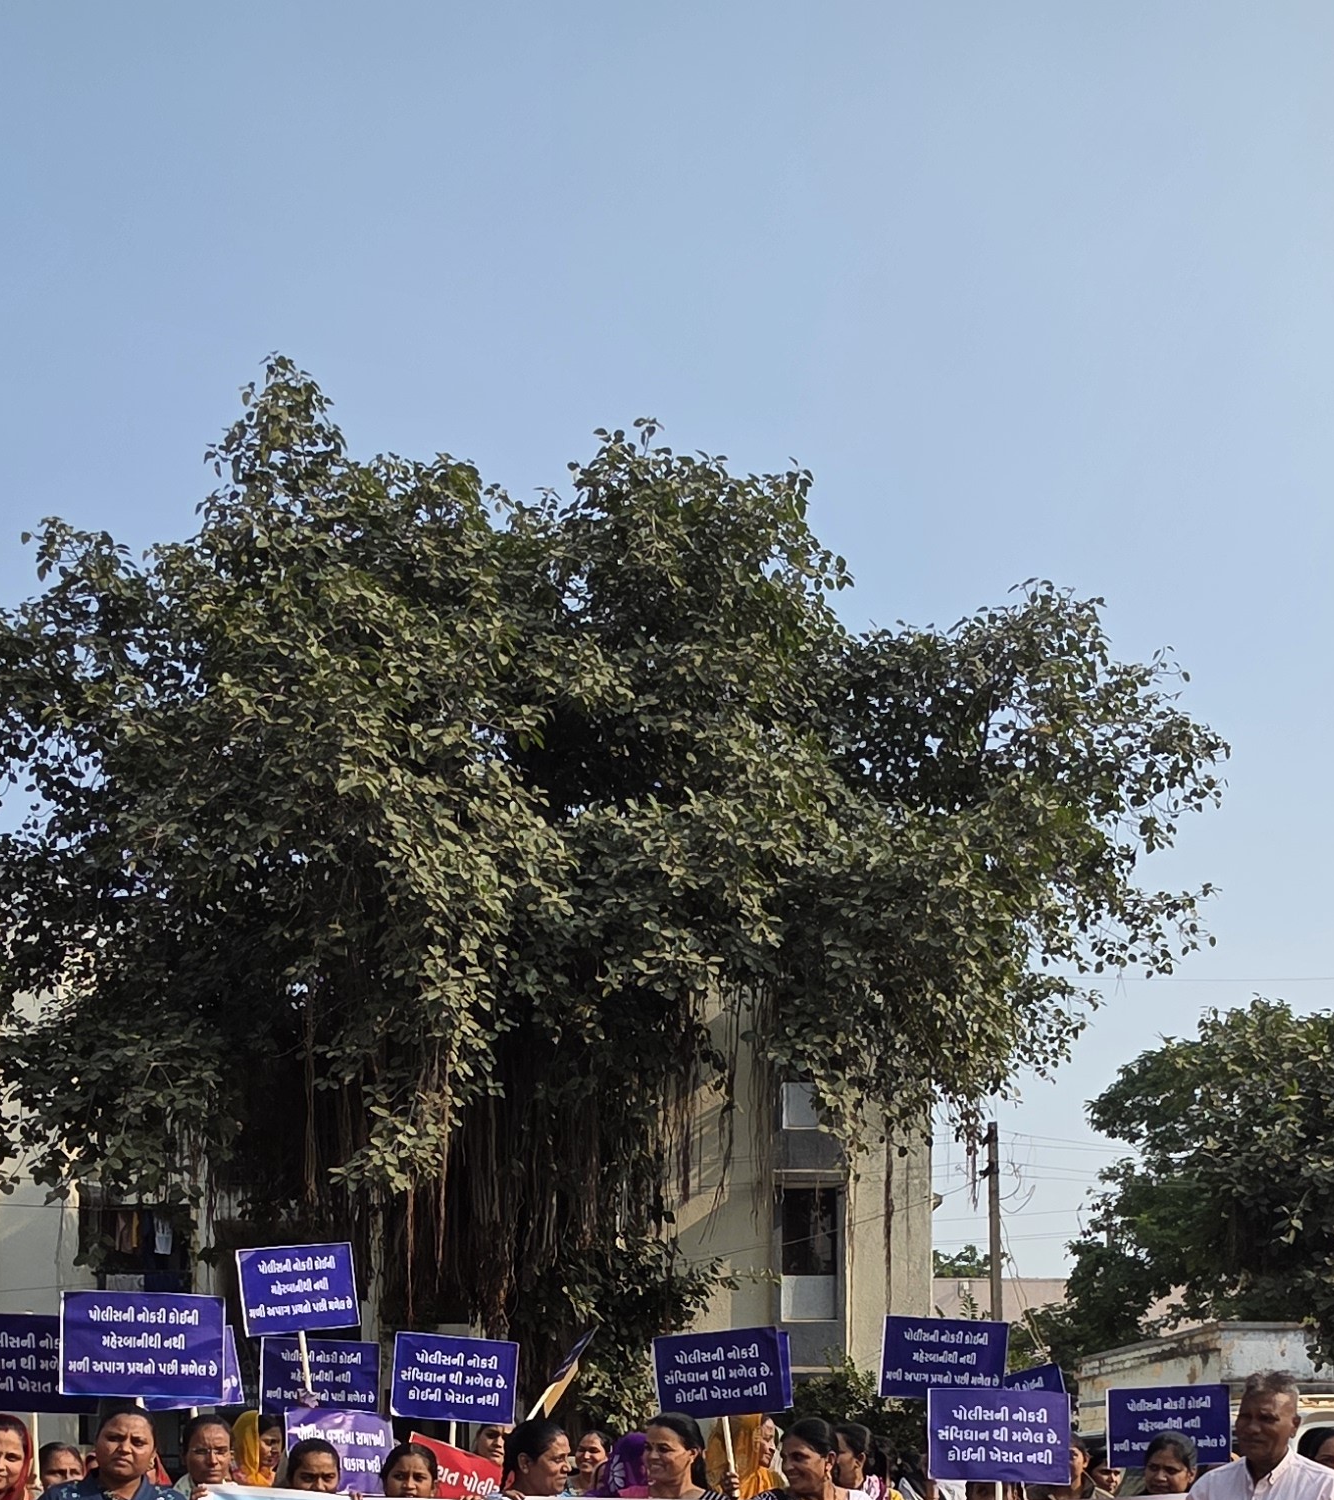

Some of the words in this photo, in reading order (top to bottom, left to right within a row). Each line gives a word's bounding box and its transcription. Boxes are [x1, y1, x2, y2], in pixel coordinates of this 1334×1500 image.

[88, 1305, 135, 1322] પોલીસની
[137, 1306, 166, 1323] નોકરી
[168, 1308, 199, 1325] કોઈની
[163, 1333, 185, 1350] નથી
[20, 1354, 36, 1370] થી
[415, 1349, 465, 1367] પોલીસની
[467, 1354, 498, 1370] નોકરી
[674, 1347, 724, 1364] પોલીસની
[727, 1343, 759, 1359] નોકરી
[68, 1356, 90, 1373] મળી
[158, 1359, 178, 1375] પછી
[181, 1359, 206, 1376] મળેલ
[208, 1360, 218, 1376] છે
[664, 1370, 709, 1385] સંવિધાન
[712, 1366, 726, 1380] થી
[729, 1364, 757, 1379] મળેલ
[17, 1376, 51, 1393] ખેરાત
[401, 1366, 446, 1384] સંવિધાન
[449, 1371, 463, 1385] થી
[465, 1373, 493, 1388] મળેલ
[444, 1389, 474, 1404] ખેરાત
[477, 1393, 499, 1406] નથી
[675, 1387, 708, 1403] કોઈની
[710, 1385, 741, 1399] ખેરાત
[743, 1382, 767, 1397] નથી
[952, 1405, 1009, 1421] પોલીસની
[1012, 1407, 1047, 1423] નોકરી
[937, 1425, 989, 1441] સંવિધાન
[992, 1426, 1008, 1442] થી
[1012, 1427, 1044, 1443] મળેલ
[1046, 1428, 1061, 1444] છે.
[948, 1445, 985, 1462] કોઈની
[989, 1446, 1023, 1463] ખેરાત
[1027, 1449, 1052, 1464] નથી
